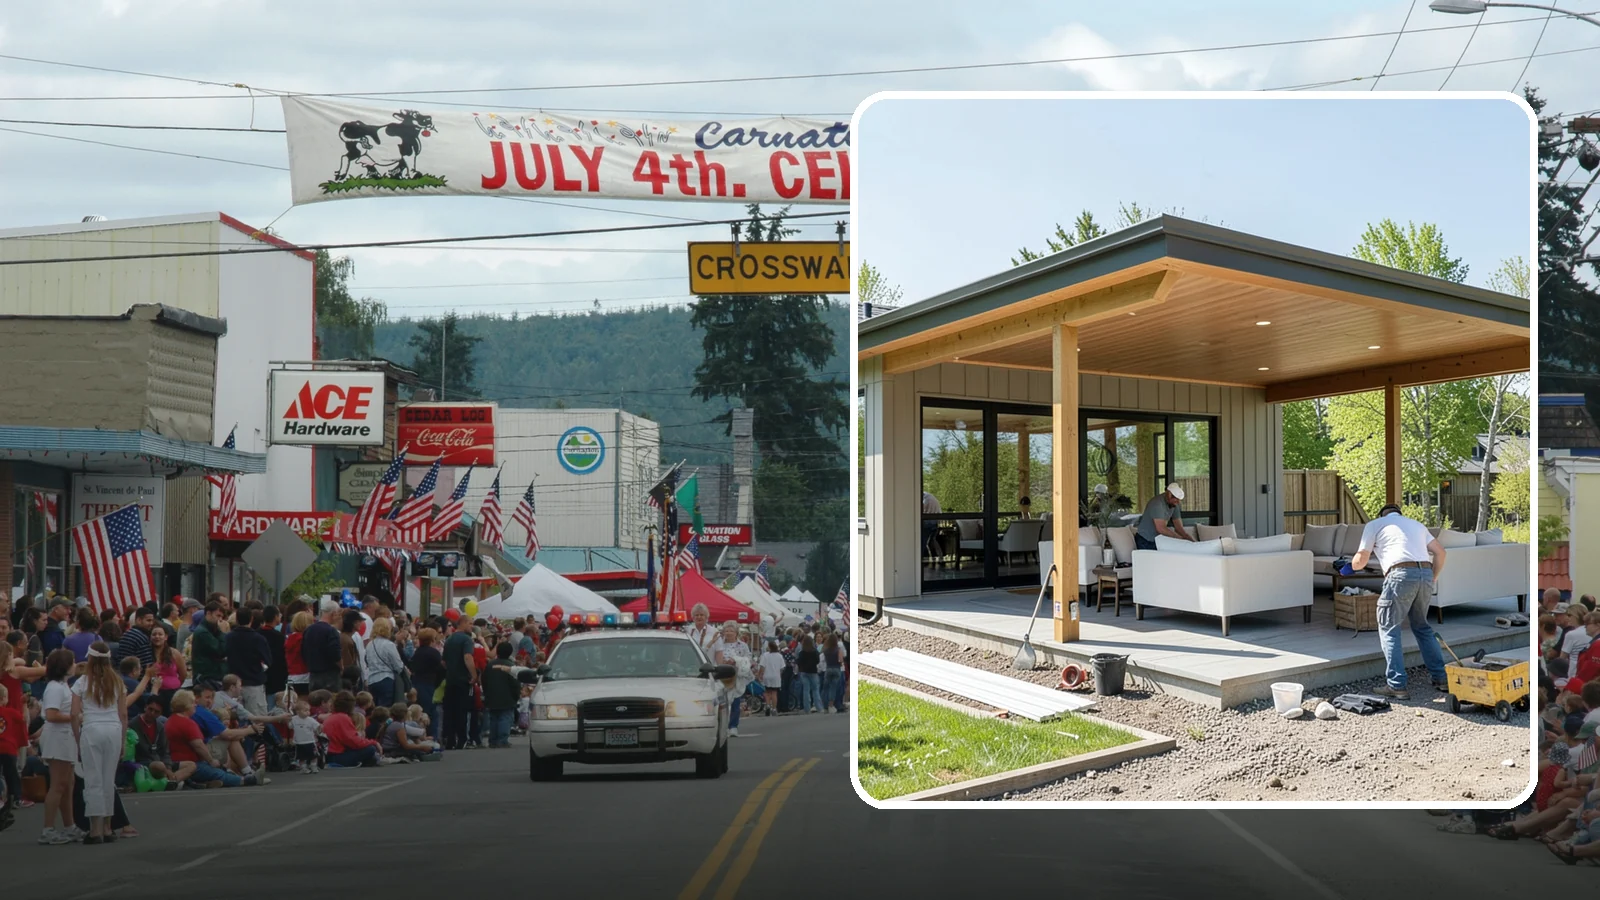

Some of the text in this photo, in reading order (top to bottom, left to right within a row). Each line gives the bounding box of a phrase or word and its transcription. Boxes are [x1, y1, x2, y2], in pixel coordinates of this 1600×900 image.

[481, 141, 605, 192] JULY
[632, 150, 746, 197] 4th.
[697, 255, 850, 280] CROSSWA
[282, 380, 373, 420] ACE
[406, 409, 485, 421] CEDAR LOG
[283, 421, 371, 436] Hardware
[416, 428, 476, 447] Coca-Cola
[353, 467, 385, 480] Simpl
[83, 485, 155, 495] St. Vincent de Paul
[688, 526, 741, 535] CRNATION
[699, 535, 730, 543] GLASS
